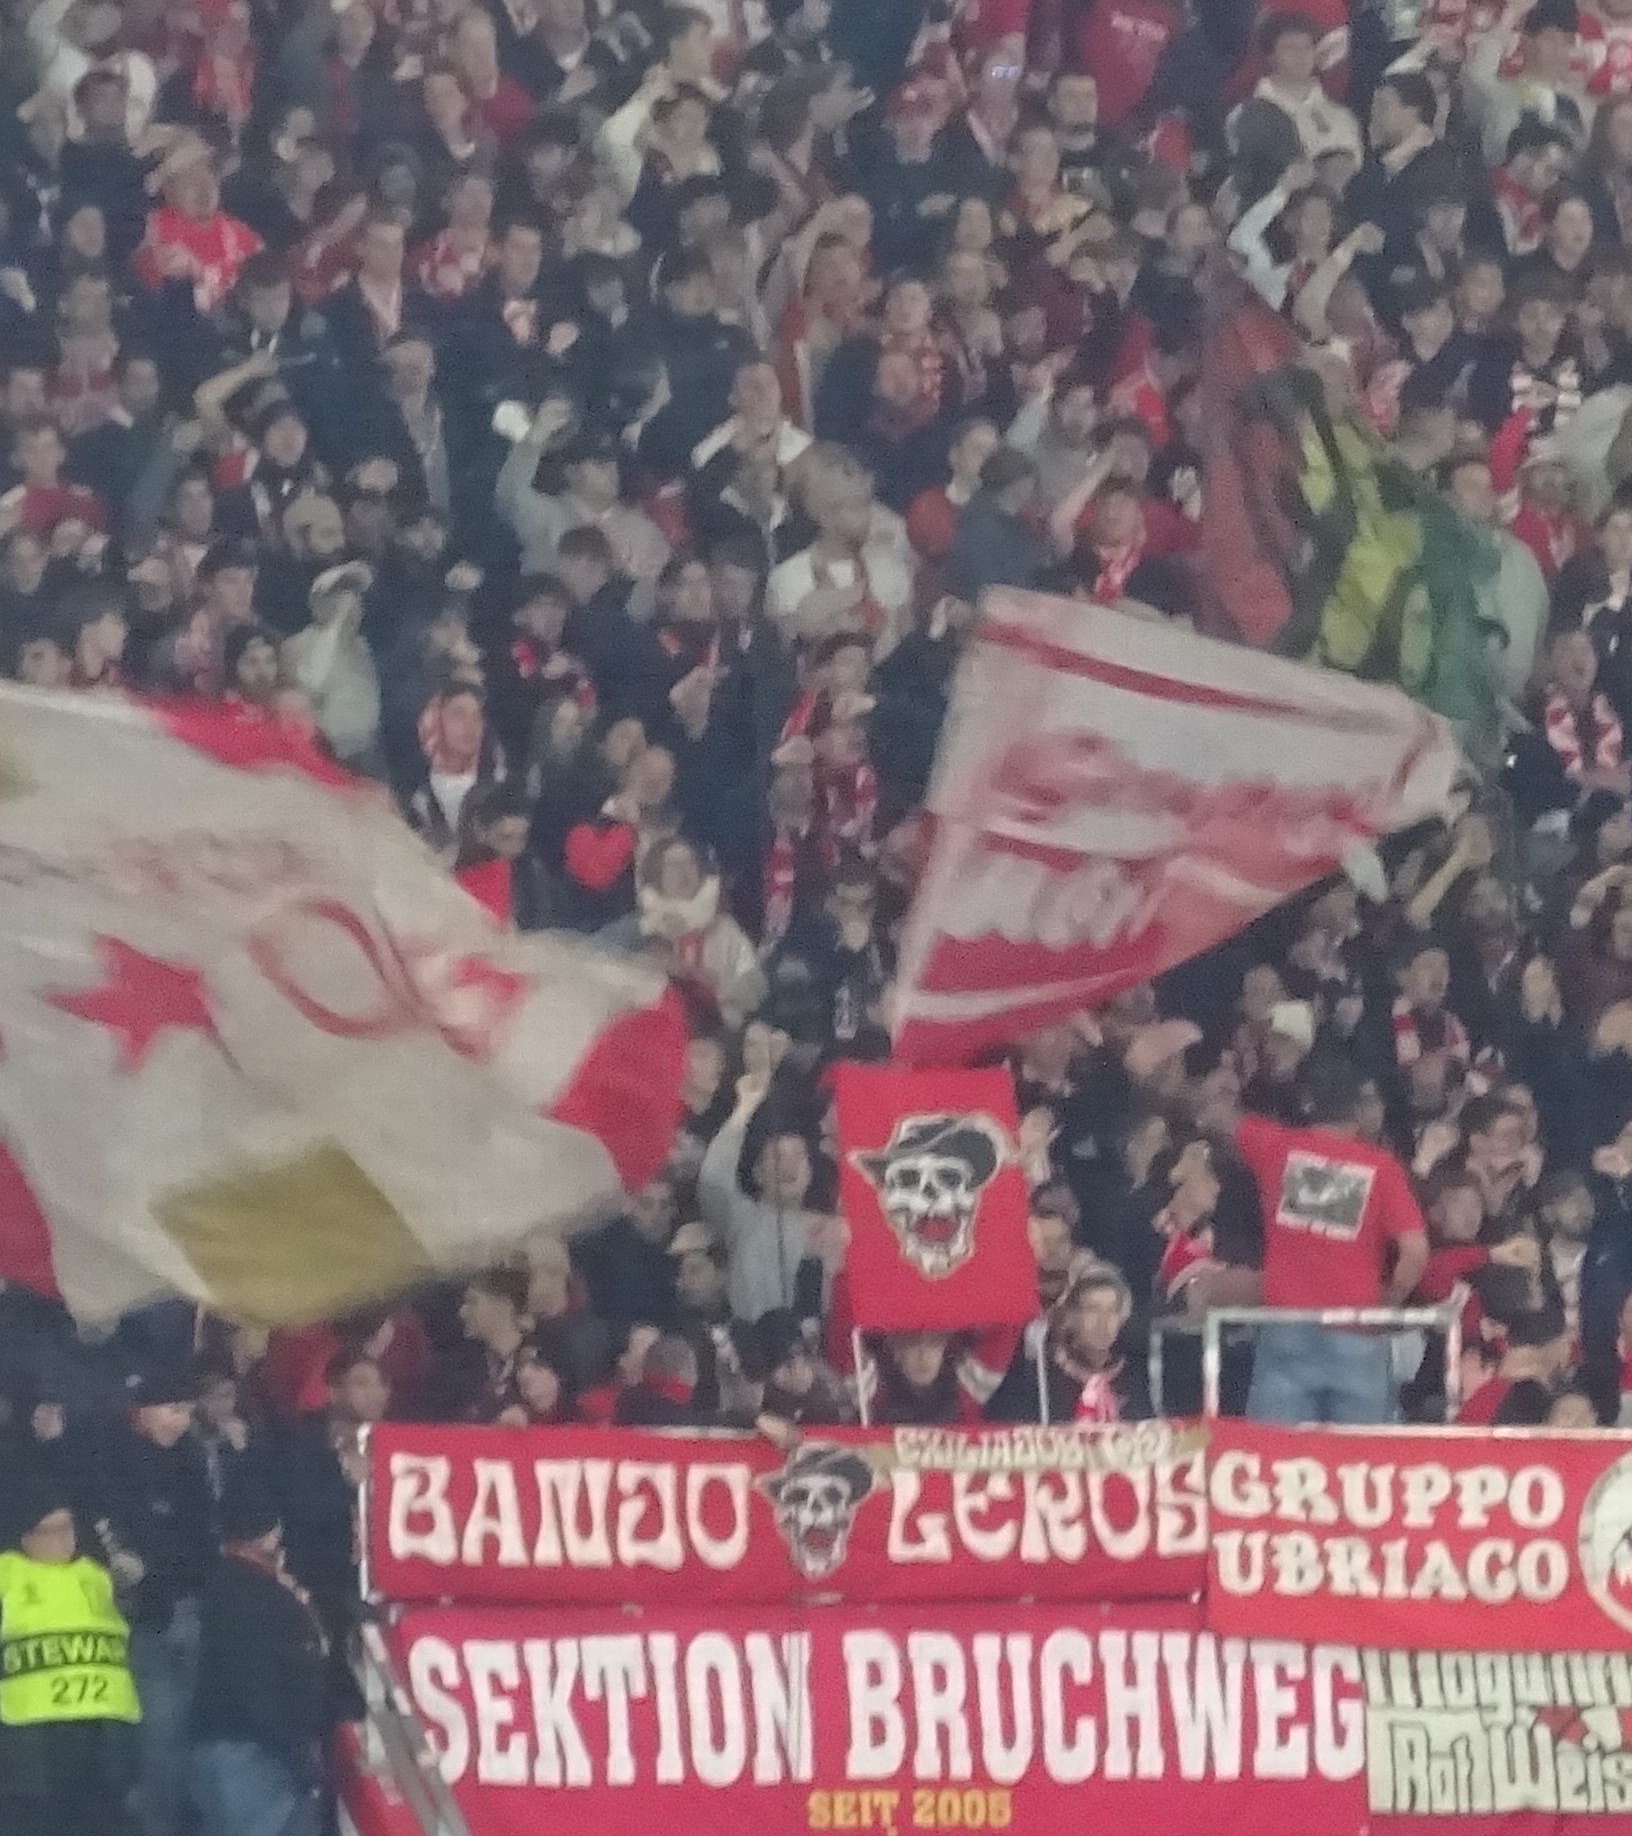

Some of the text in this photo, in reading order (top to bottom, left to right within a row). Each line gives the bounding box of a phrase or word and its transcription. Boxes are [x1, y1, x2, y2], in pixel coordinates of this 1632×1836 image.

[887, 1452, 1208, 1564] LEROS
[1210, 1445, 1566, 1528] GRUPPO
[1212, 1529, 1569, 1604] UBRIACO
[4, 1635, 128, 1672] STEWA
[52, 1674, 108, 1705] 272
[408, 1626, 1366, 1788] SEKTION BRUCHWEG
[808, 1789, 899, 1830] SEIT
